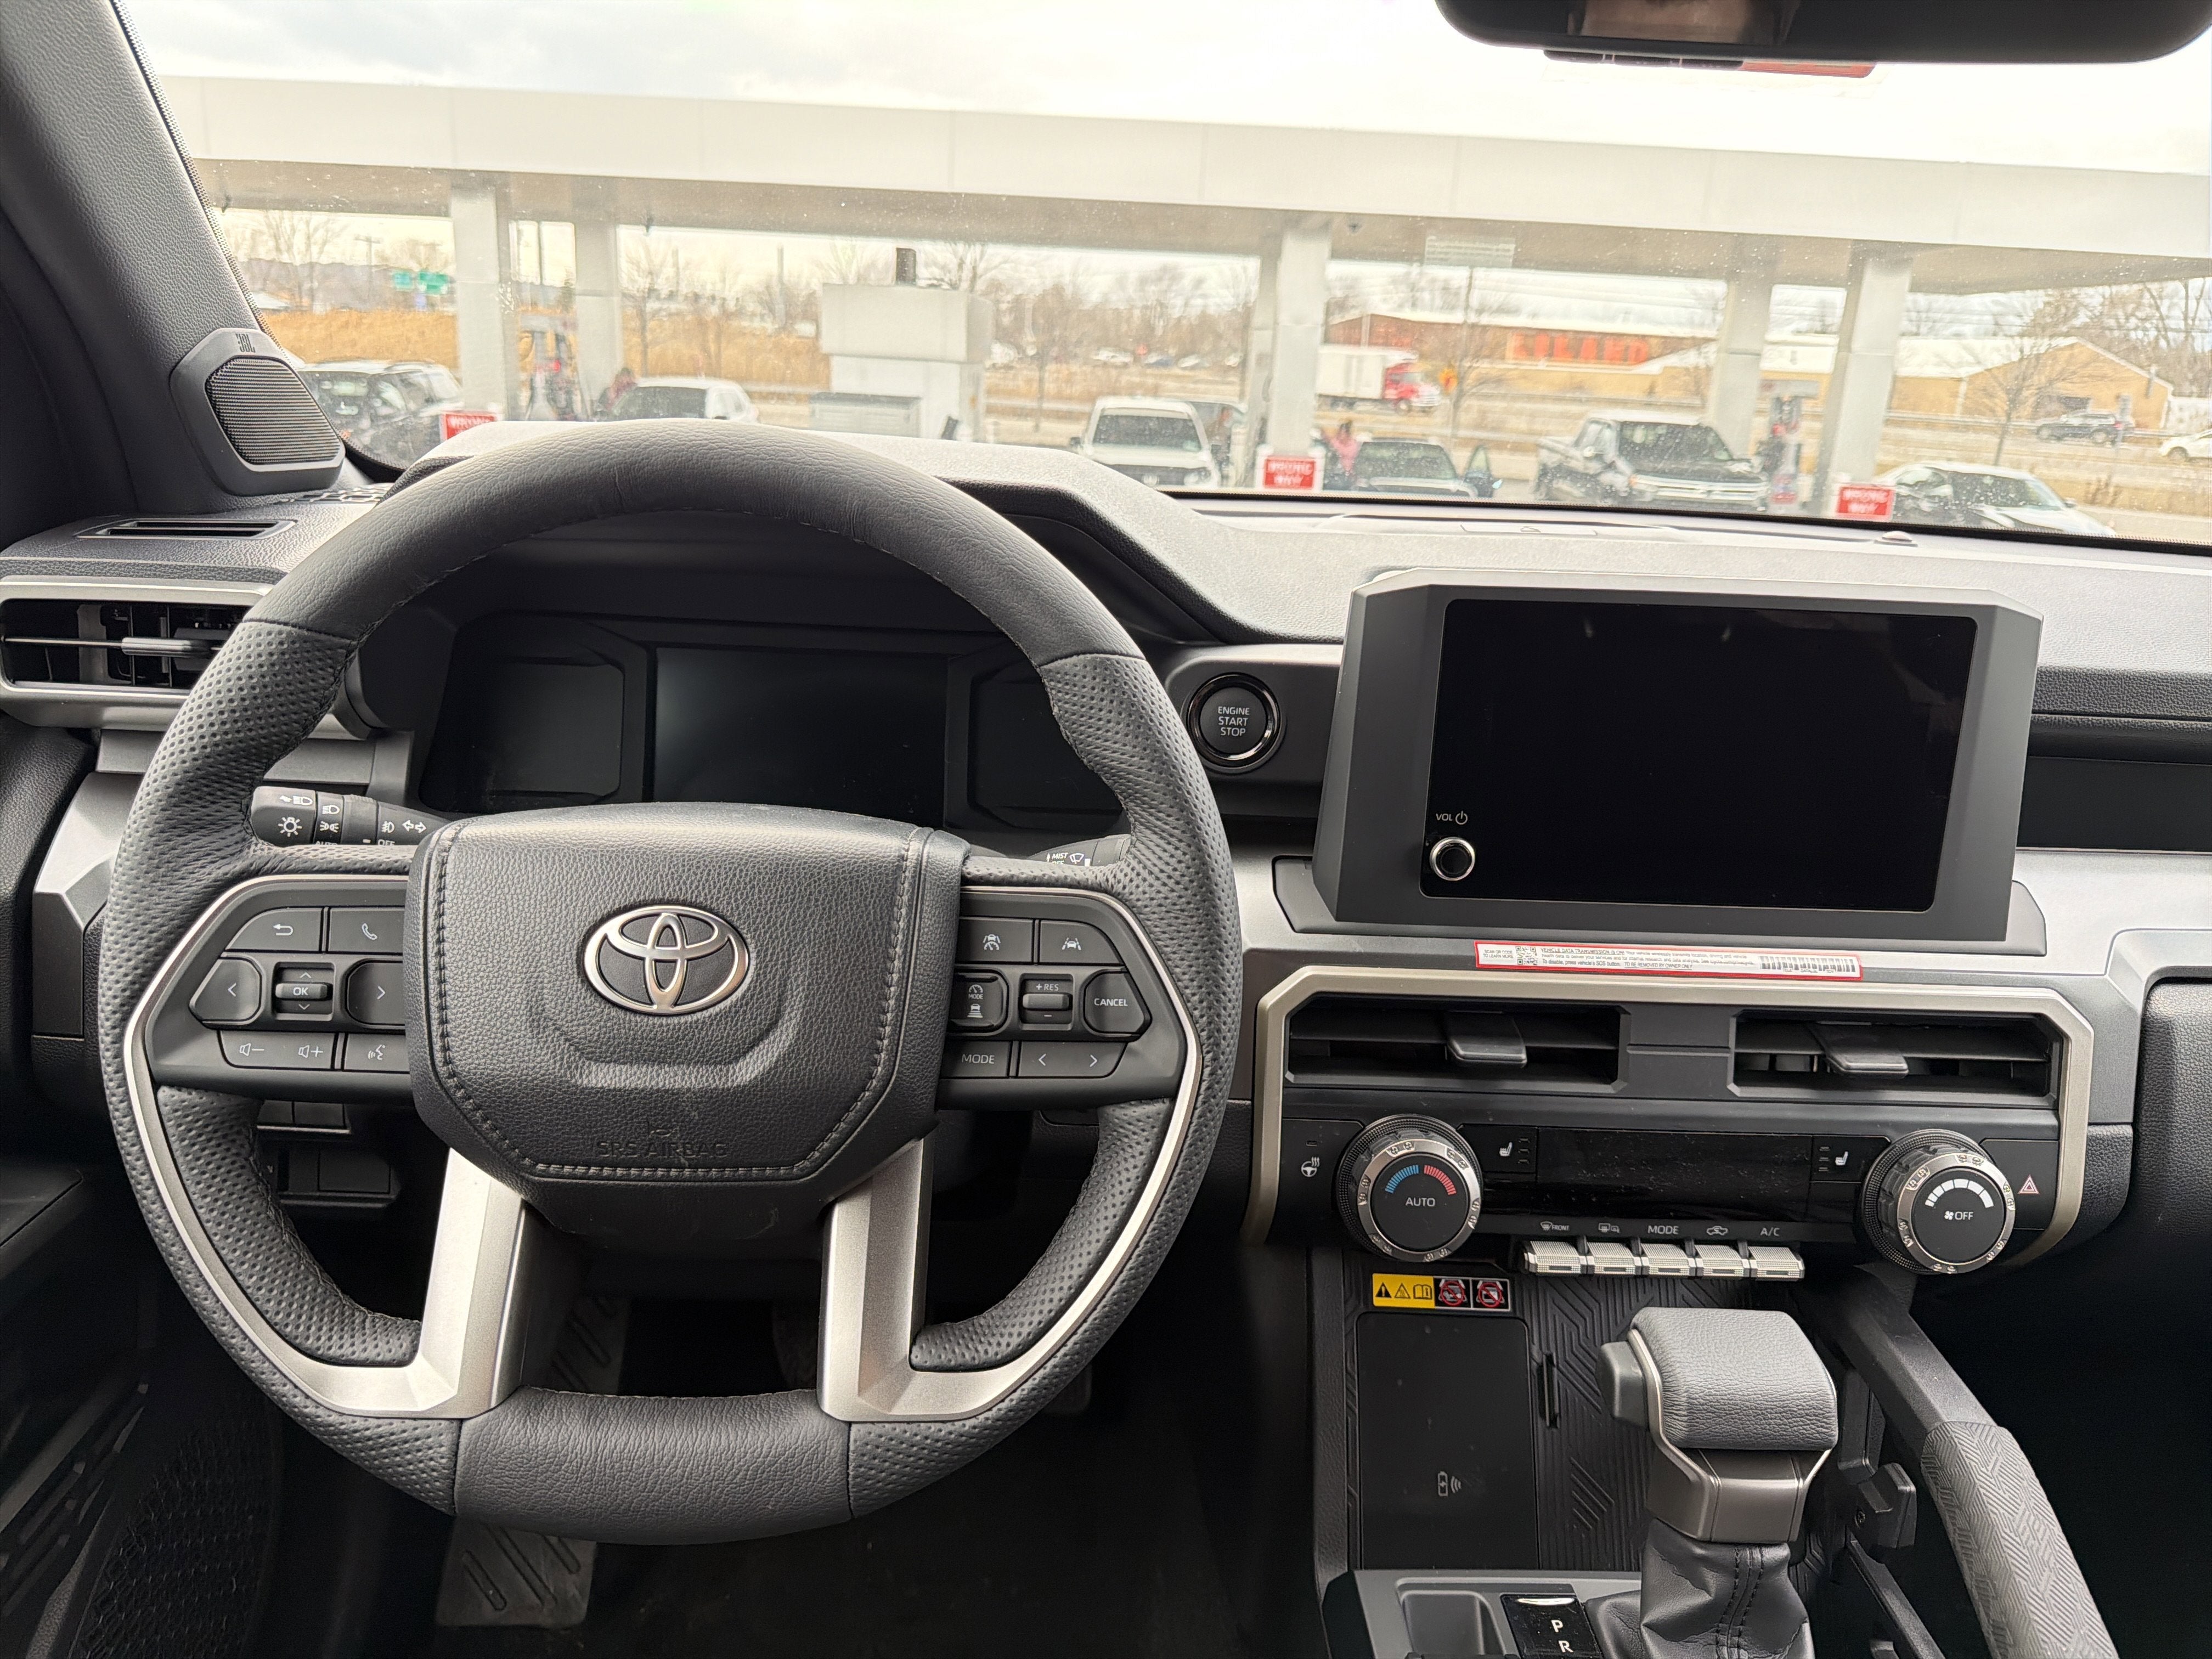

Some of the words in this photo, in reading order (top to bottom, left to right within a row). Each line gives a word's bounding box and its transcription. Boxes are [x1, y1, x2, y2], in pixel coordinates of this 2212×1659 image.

[235, 333, 256, 353] JBL
[1218, 706, 1250, 715] ENGINE
[1218, 716, 1249, 726] START
[1221, 727, 1246, 736] STOP
[1436, 813, 1453, 821] VOL
[293, 987, 308, 996] OK
[1094, 998, 1128, 1007] CANCEL
[962, 1054, 995, 1064] MODE
[1406, 1197, 1436, 1207] AUTO
[1955, 1211, 1974, 1220] OFF
[1647, 1225, 1679, 1235] MODE
[1760, 1227, 1780, 1237] A/C
[1551, 1620, 1564, 1633] P
[1558, 1640, 1574, 1653] R
